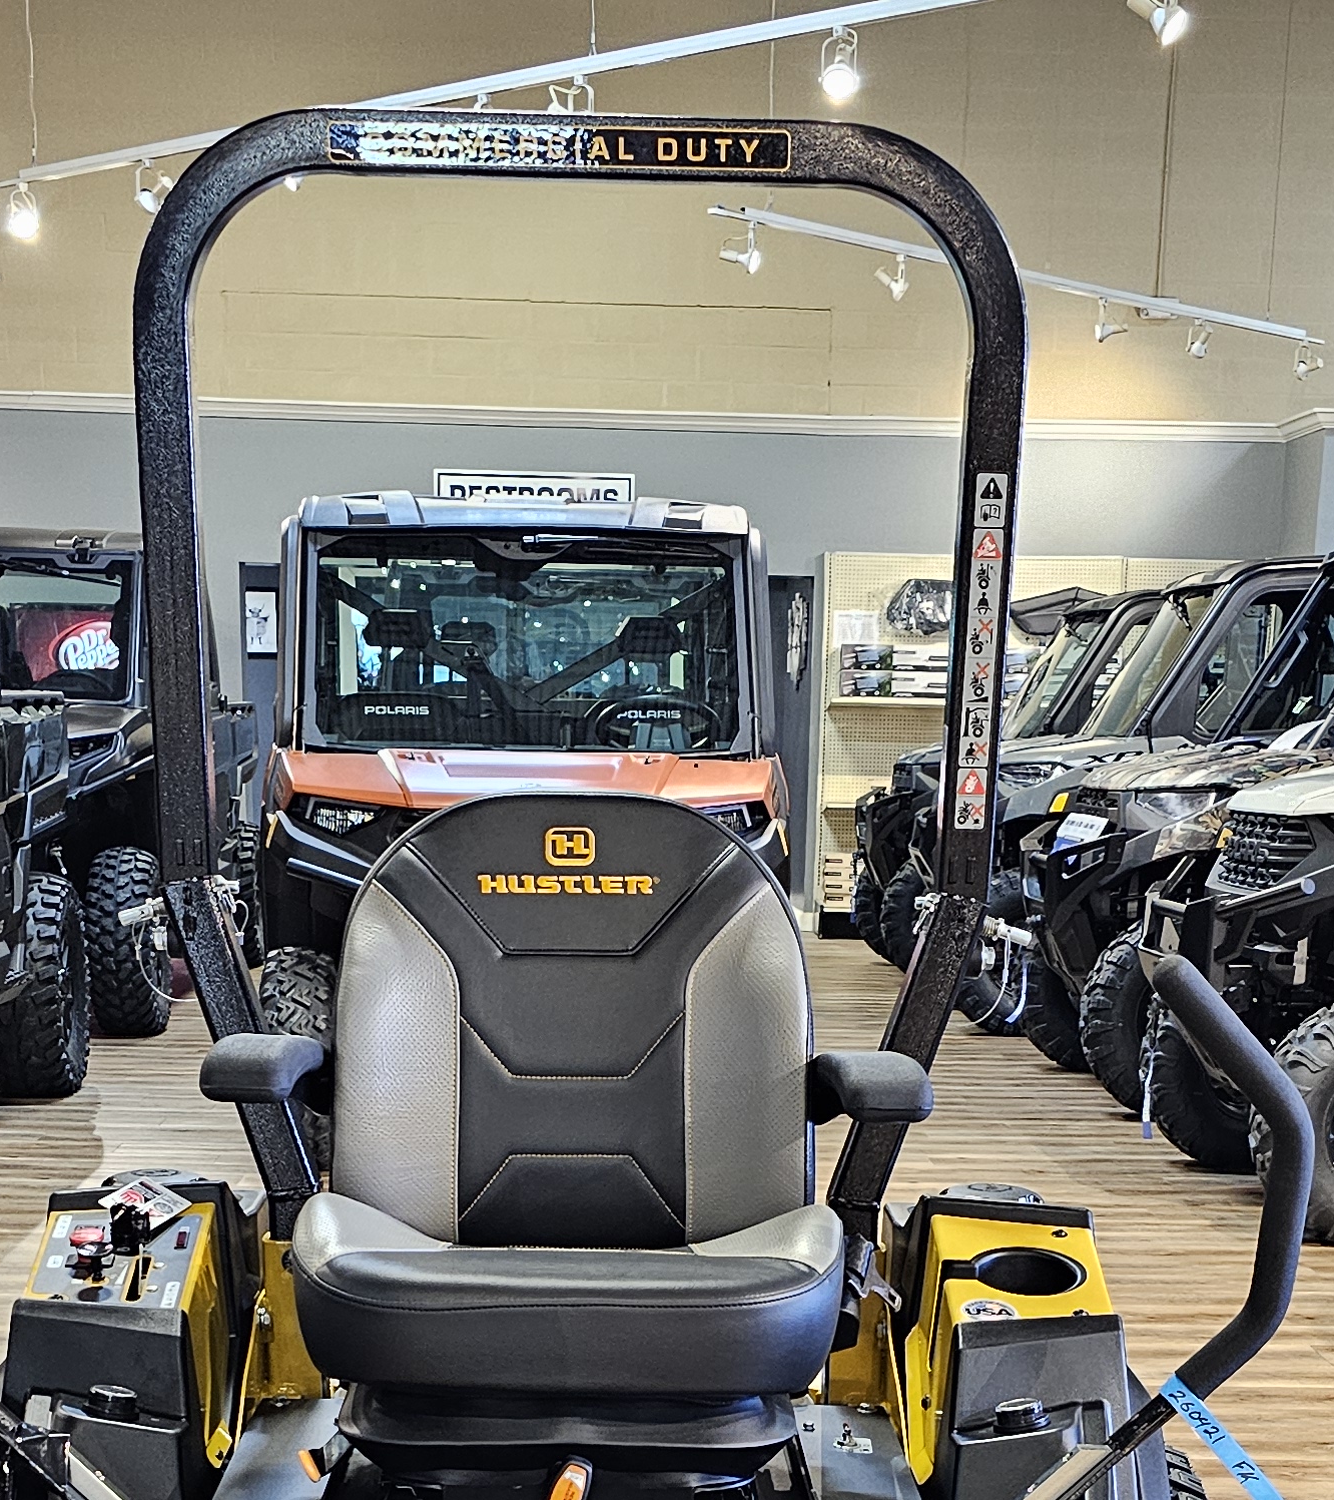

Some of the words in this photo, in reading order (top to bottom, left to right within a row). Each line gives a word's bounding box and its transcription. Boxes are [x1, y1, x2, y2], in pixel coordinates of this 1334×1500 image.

[657, 136, 761, 164] DUTY
[81, 628, 108, 648] Dr
[58, 636, 119, 670] Peppe
[364, 705, 430, 716] POLARIS
[477, 874, 654, 895] HUSTLER
[965, 1308, 1014, 1317] USA
[1168, 1390, 1226, 1445] 260421
